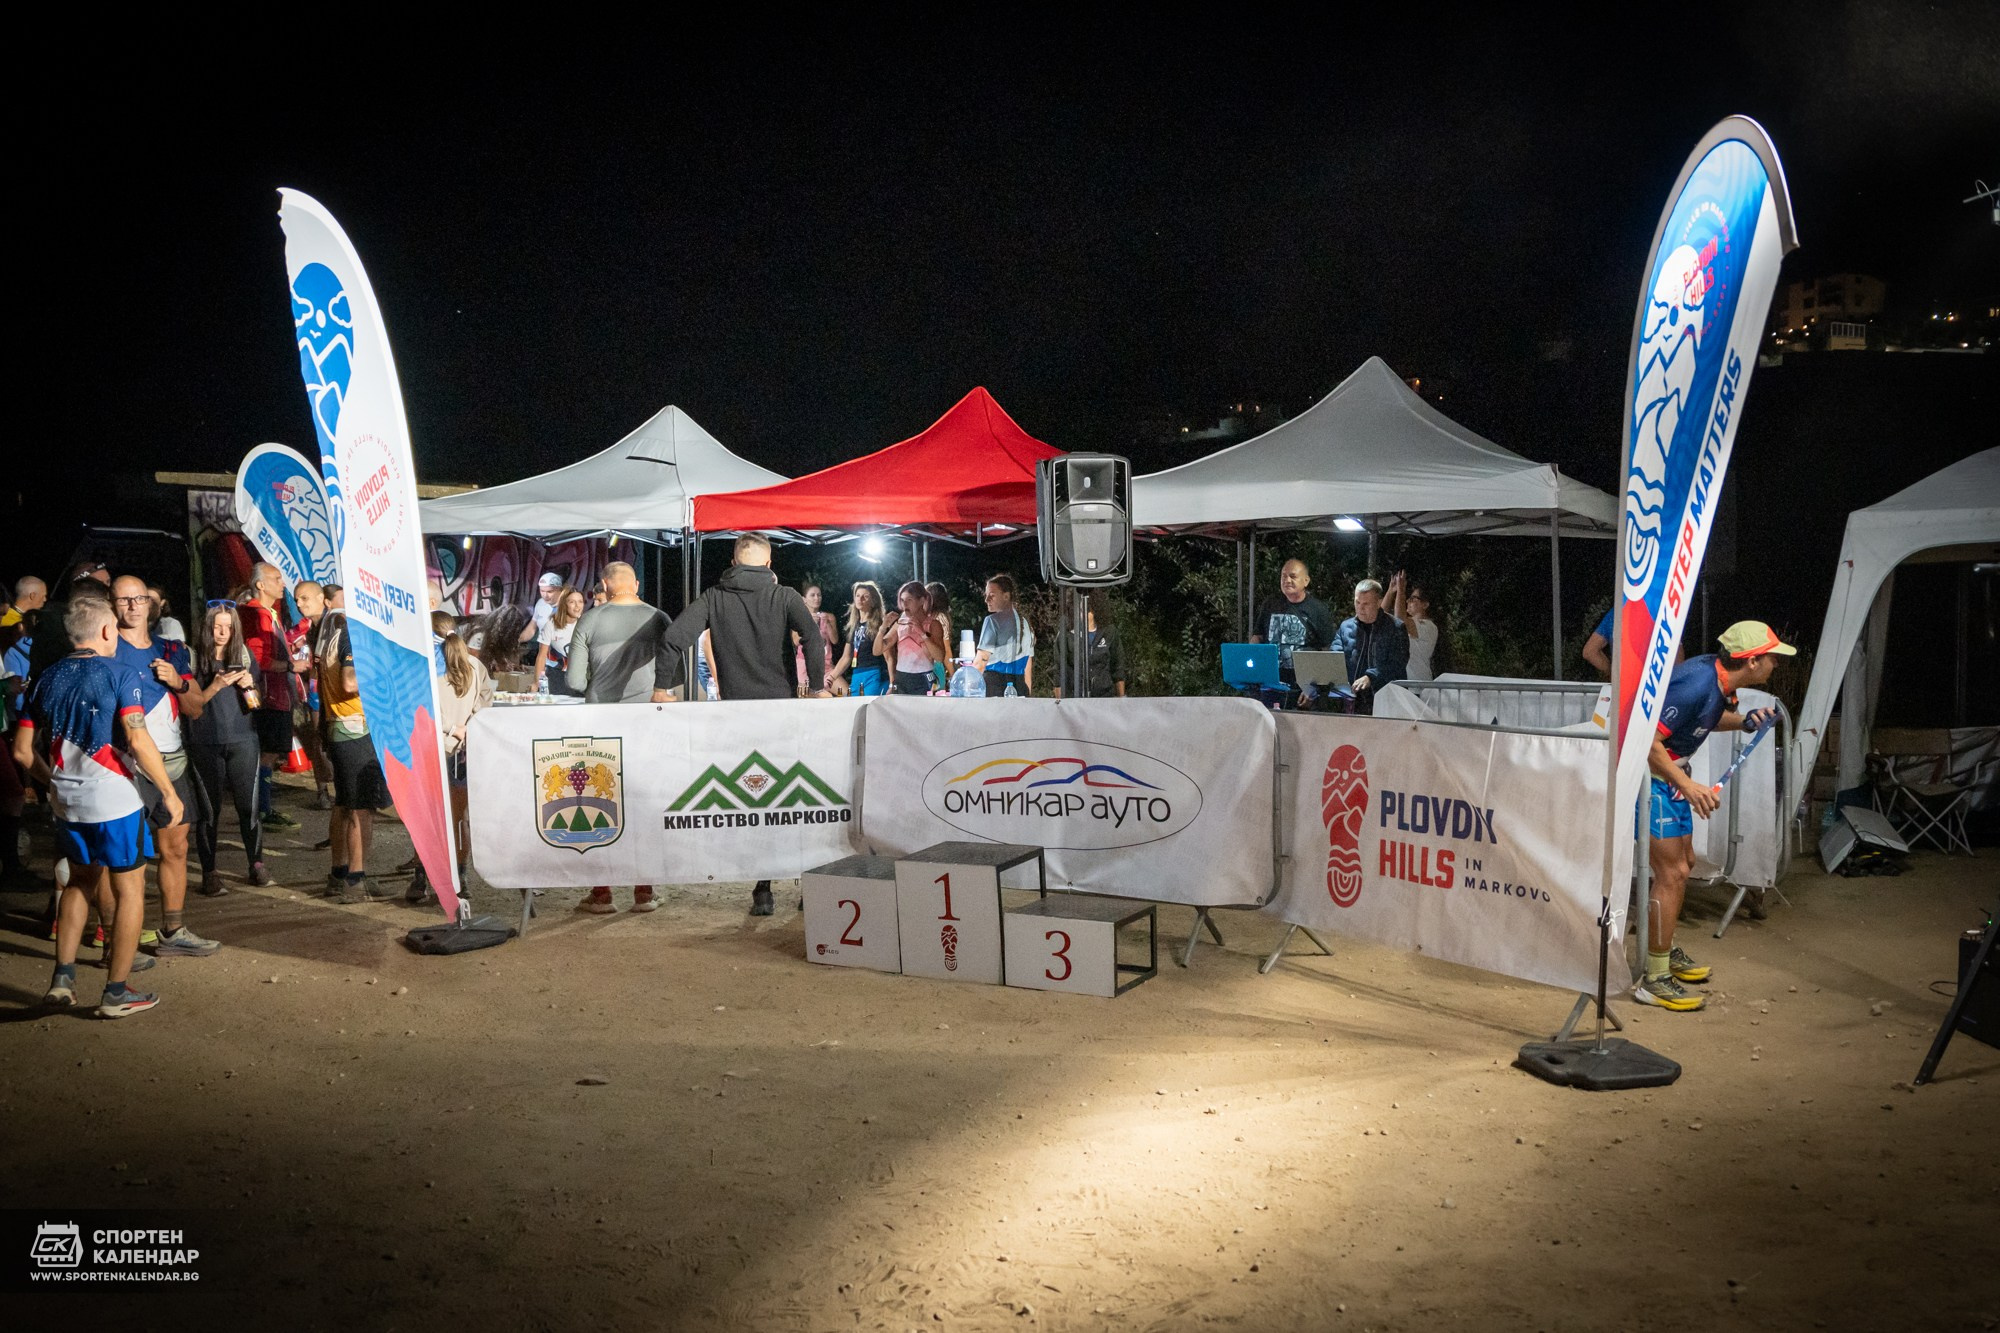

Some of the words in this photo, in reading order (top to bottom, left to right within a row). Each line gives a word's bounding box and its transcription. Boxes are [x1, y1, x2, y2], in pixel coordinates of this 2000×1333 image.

[1690, 267, 1714, 306] HILLS
[1642, 606, 1674, 722] EVERY
[1668, 519, 1693, 619] STEP
[1690, 348, 1742, 530] MATTERS
[664, 812, 760, 830] КМЕТСТВО
[764, 808, 852, 826] МАРКОВО
[1379, 839, 1455, 889] HILLS
[1465, 857, 1482, 872] IN
[934, 872, 961, 921] 1
[1465, 876, 1551, 902] MARKOVO
[838, 899, 863, 947] 2
[1045, 930, 1072, 980] 3
